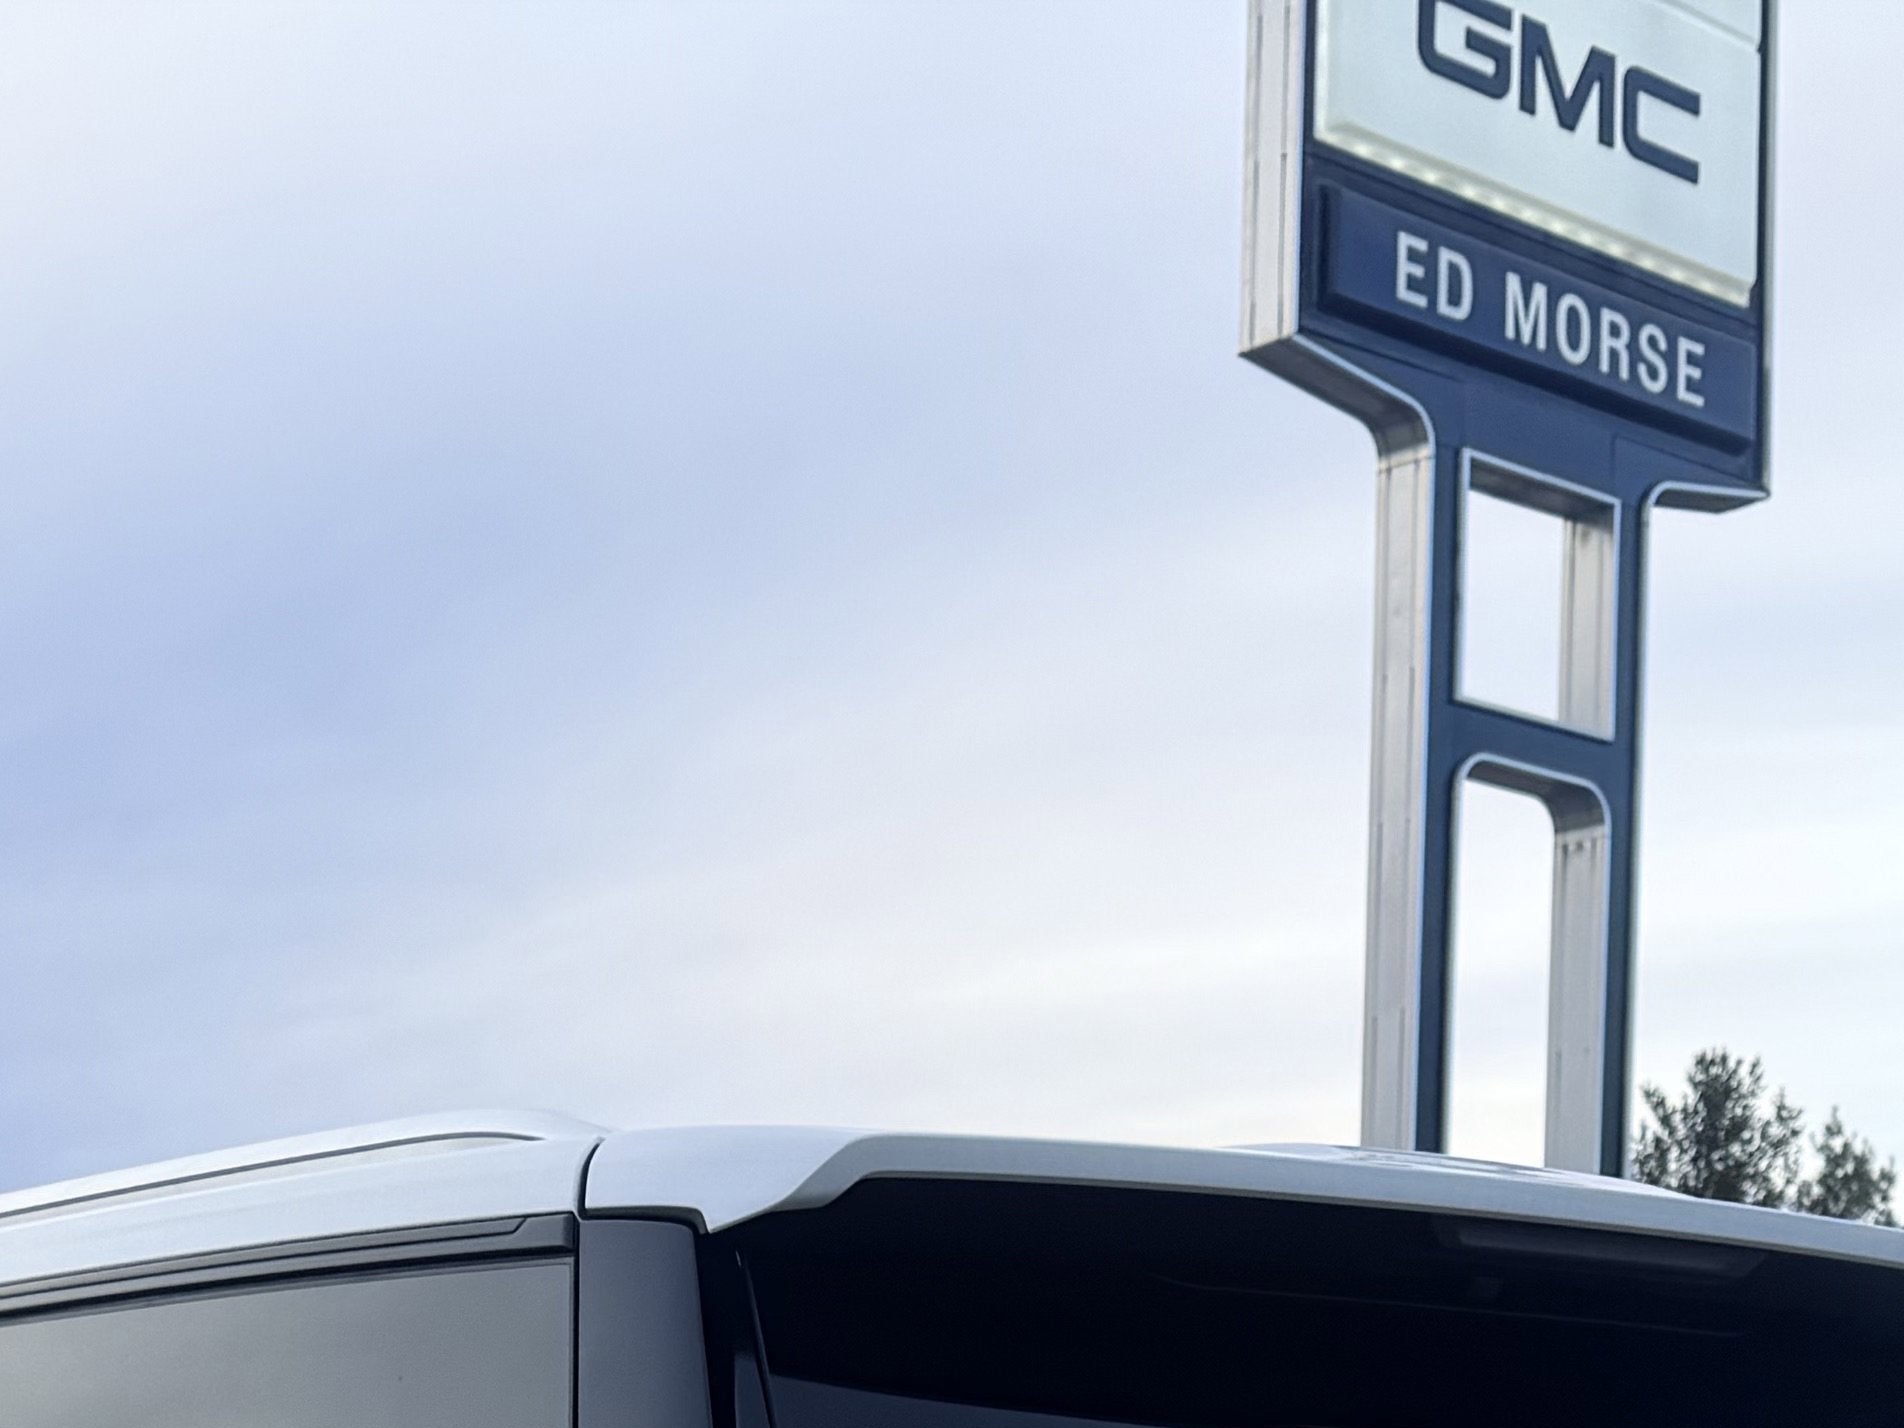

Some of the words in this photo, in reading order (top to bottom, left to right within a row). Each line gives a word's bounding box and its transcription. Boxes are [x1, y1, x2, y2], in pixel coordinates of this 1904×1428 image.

[1417, 0, 1701, 185] GMC
[1395, 230, 1474, 321] ED
[1505, 271, 1705, 407] MORSE
